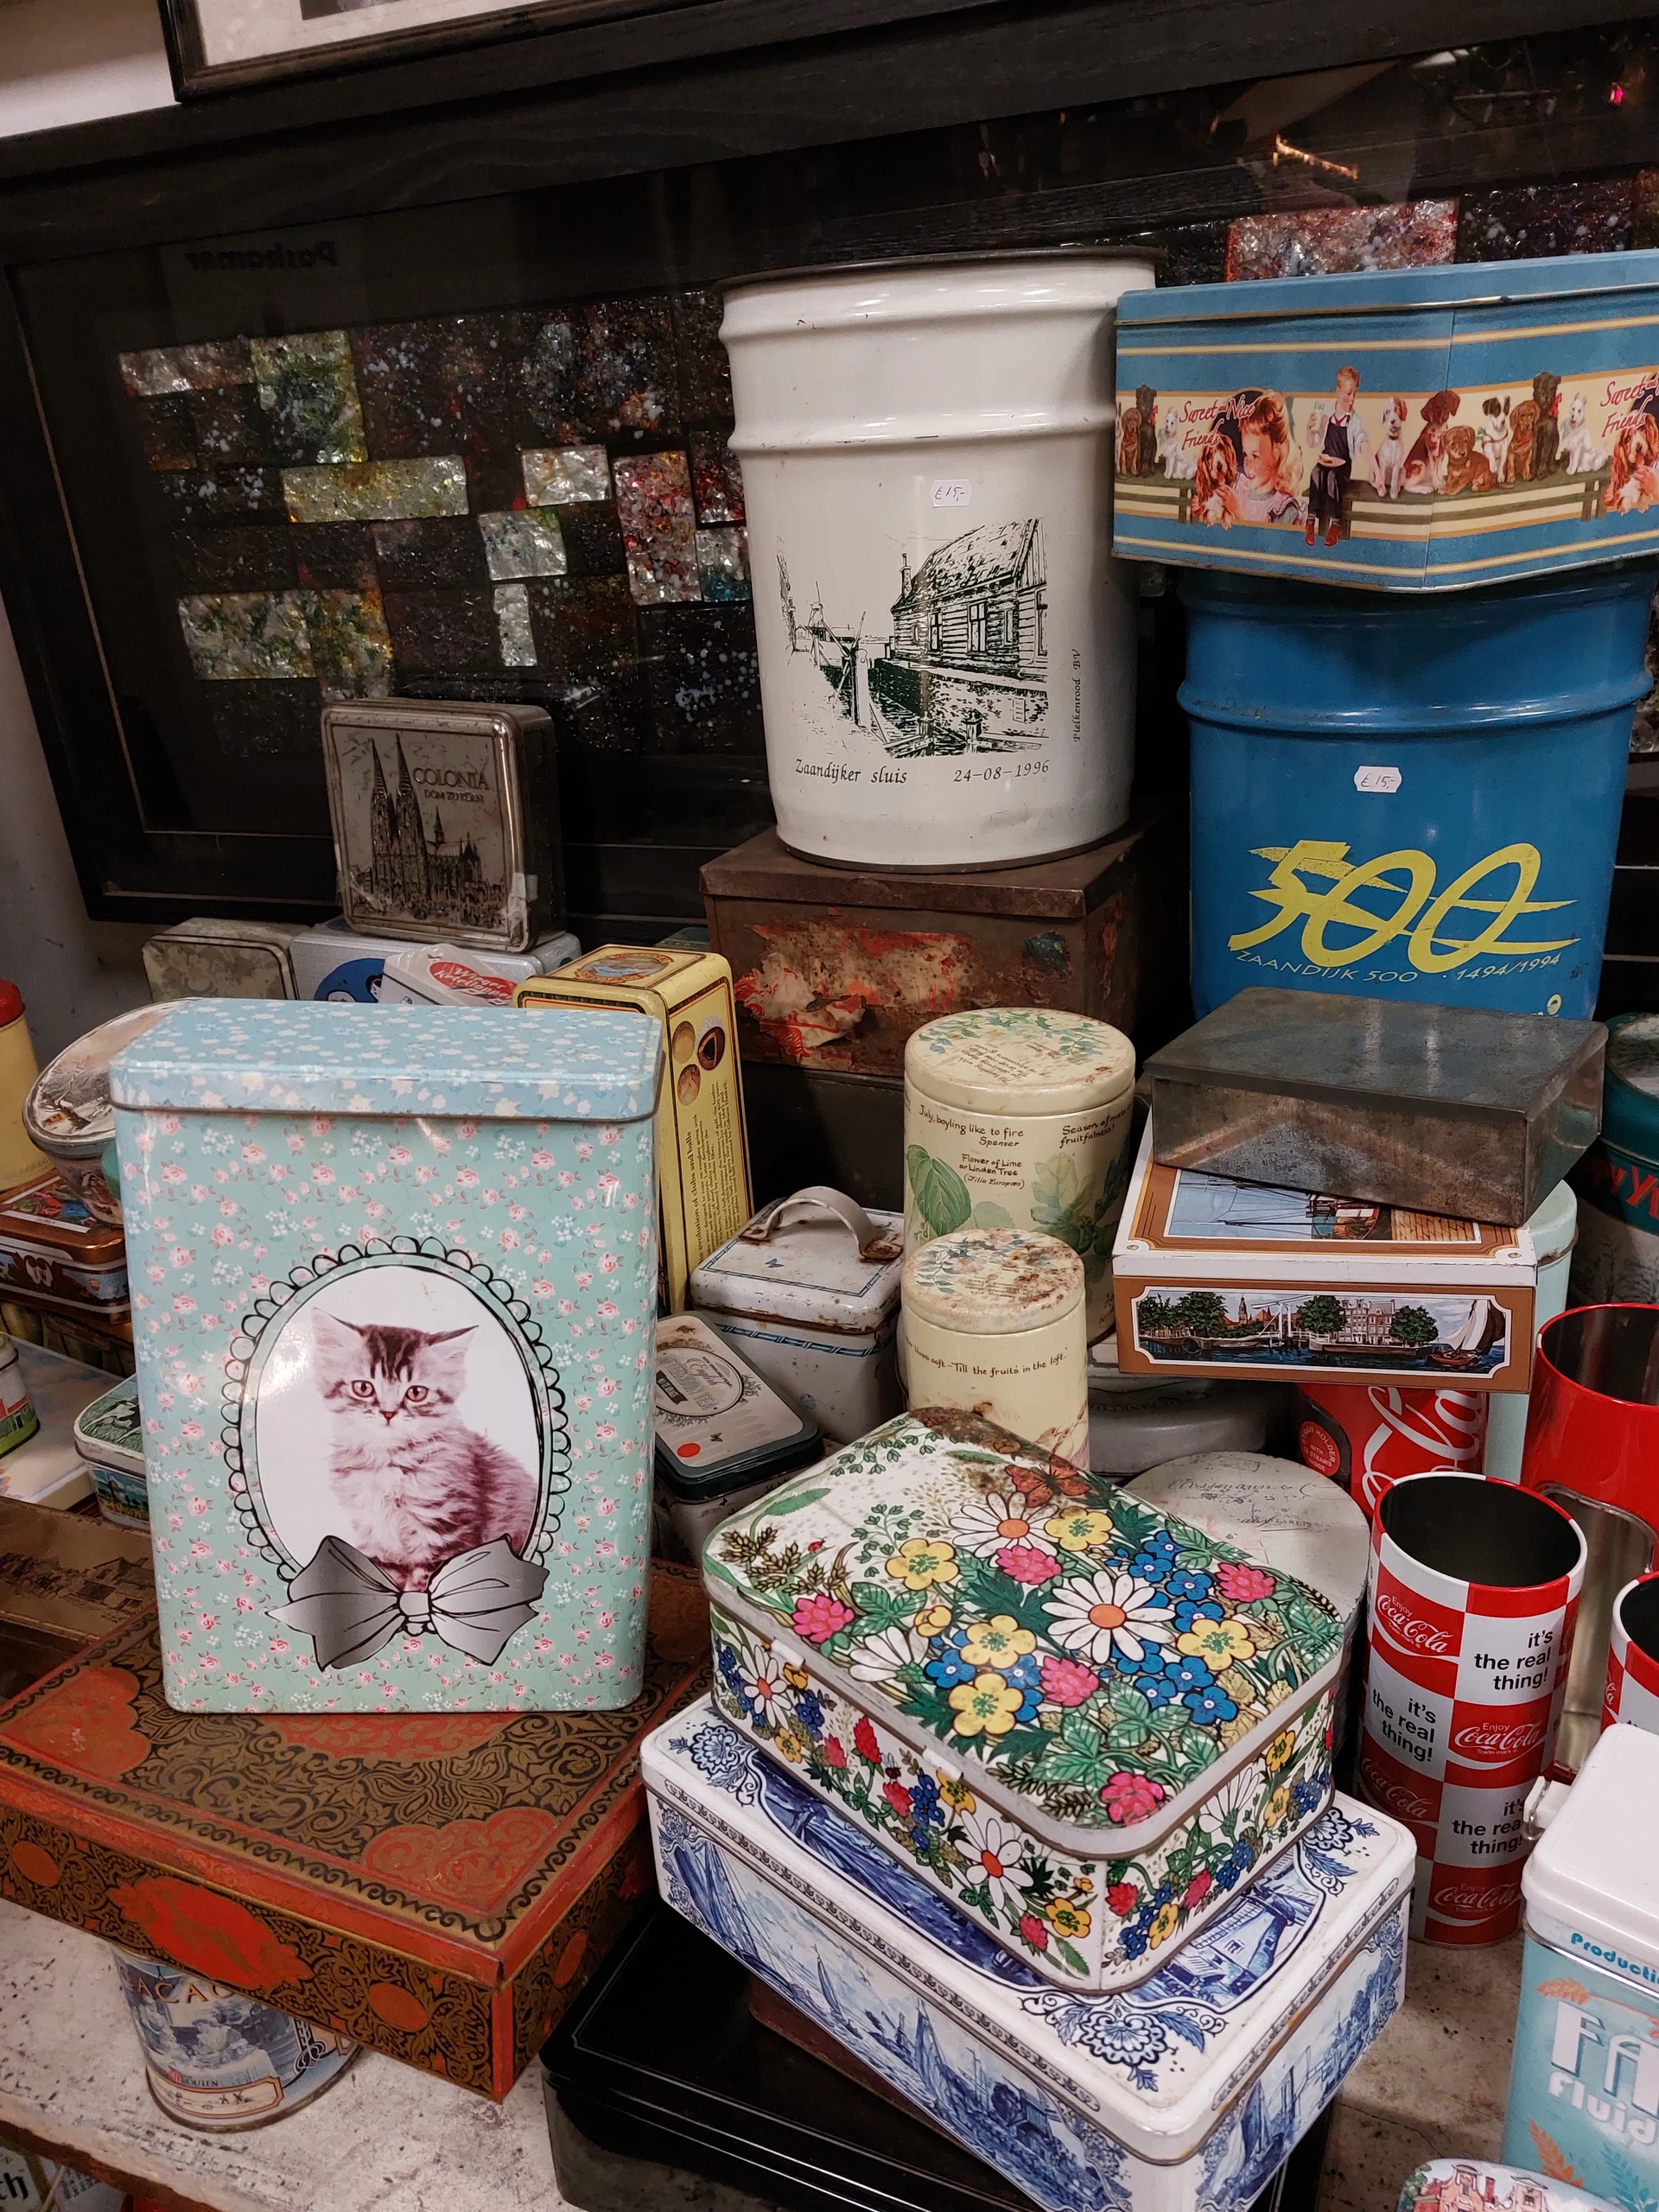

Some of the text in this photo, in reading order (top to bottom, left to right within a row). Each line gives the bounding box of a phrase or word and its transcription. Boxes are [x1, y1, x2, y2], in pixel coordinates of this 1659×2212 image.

[1600, 374, 1646, 407] Sweet
[1179, 398, 1218, 423] Sweet
[1226, 394, 1255, 421] Nice
[1601, 395, 1654, 438] Friends
[1181, 418, 1224, 451] Friends
[1071, 649, 1081, 742] Pielkenrood BV
[413, 767, 490, 791] COLONIA
[795, 758, 861, 785] Zaandijker
[870, 766, 907, 785] sluis
[424, 789, 485, 804] DOM ZU KÖLN
[1228, 839, 1555, 974] 500
[454, 967, 506, 989] Wieger
[1235, 950, 1562, 983] ZAANDIJK 500 1494/1994
[918, 1104, 1025, 1140] July, boyling like to fire
[1062, 1123, 1099, 1136] Season
[1100, 1115, 1110, 1128] of
[978, 1135, 1020, 1148] Spenser
[1058, 1122, 1116, 1149] fruitfulness!
[961, 1153, 1022, 1169] Flower of Lime
[969, 1163, 996, 1175] Linden
[998, 1167, 1019, 1176] Tree
[691, 1198, 698, 1208] of
[695, 1208, 703, 1251] evolution
[972, 1365, 988, 1376] the
[1022, 1365, 1031, 1374] in
[1032, 1361, 1047, 1373] the
[1315, 1428, 1337, 1463] HOLDER
[1390, 1594, 1413, 1618] Enjoy
[1377, 1594, 1454, 1654] Coca-Cola
[1528, 1630, 1554, 1649] it's
[1473, 1646, 1551, 1671] the real
[1493, 1666, 1548, 1691] thing!
[1372, 1688, 1435, 1744] the real
[1408, 1697, 1436, 1725] it's
[1454, 1719, 1543, 1751] Coca-Cola
[1482, 1722, 1510, 1732] Enjoy
[1382, 1719, 1433, 1764] thing!
[1452, 1818, 1522, 1837] the rea
[1459, 1883, 1486, 1894] Enjoy
[181, 2078, 219, 2088] HOUTEN
